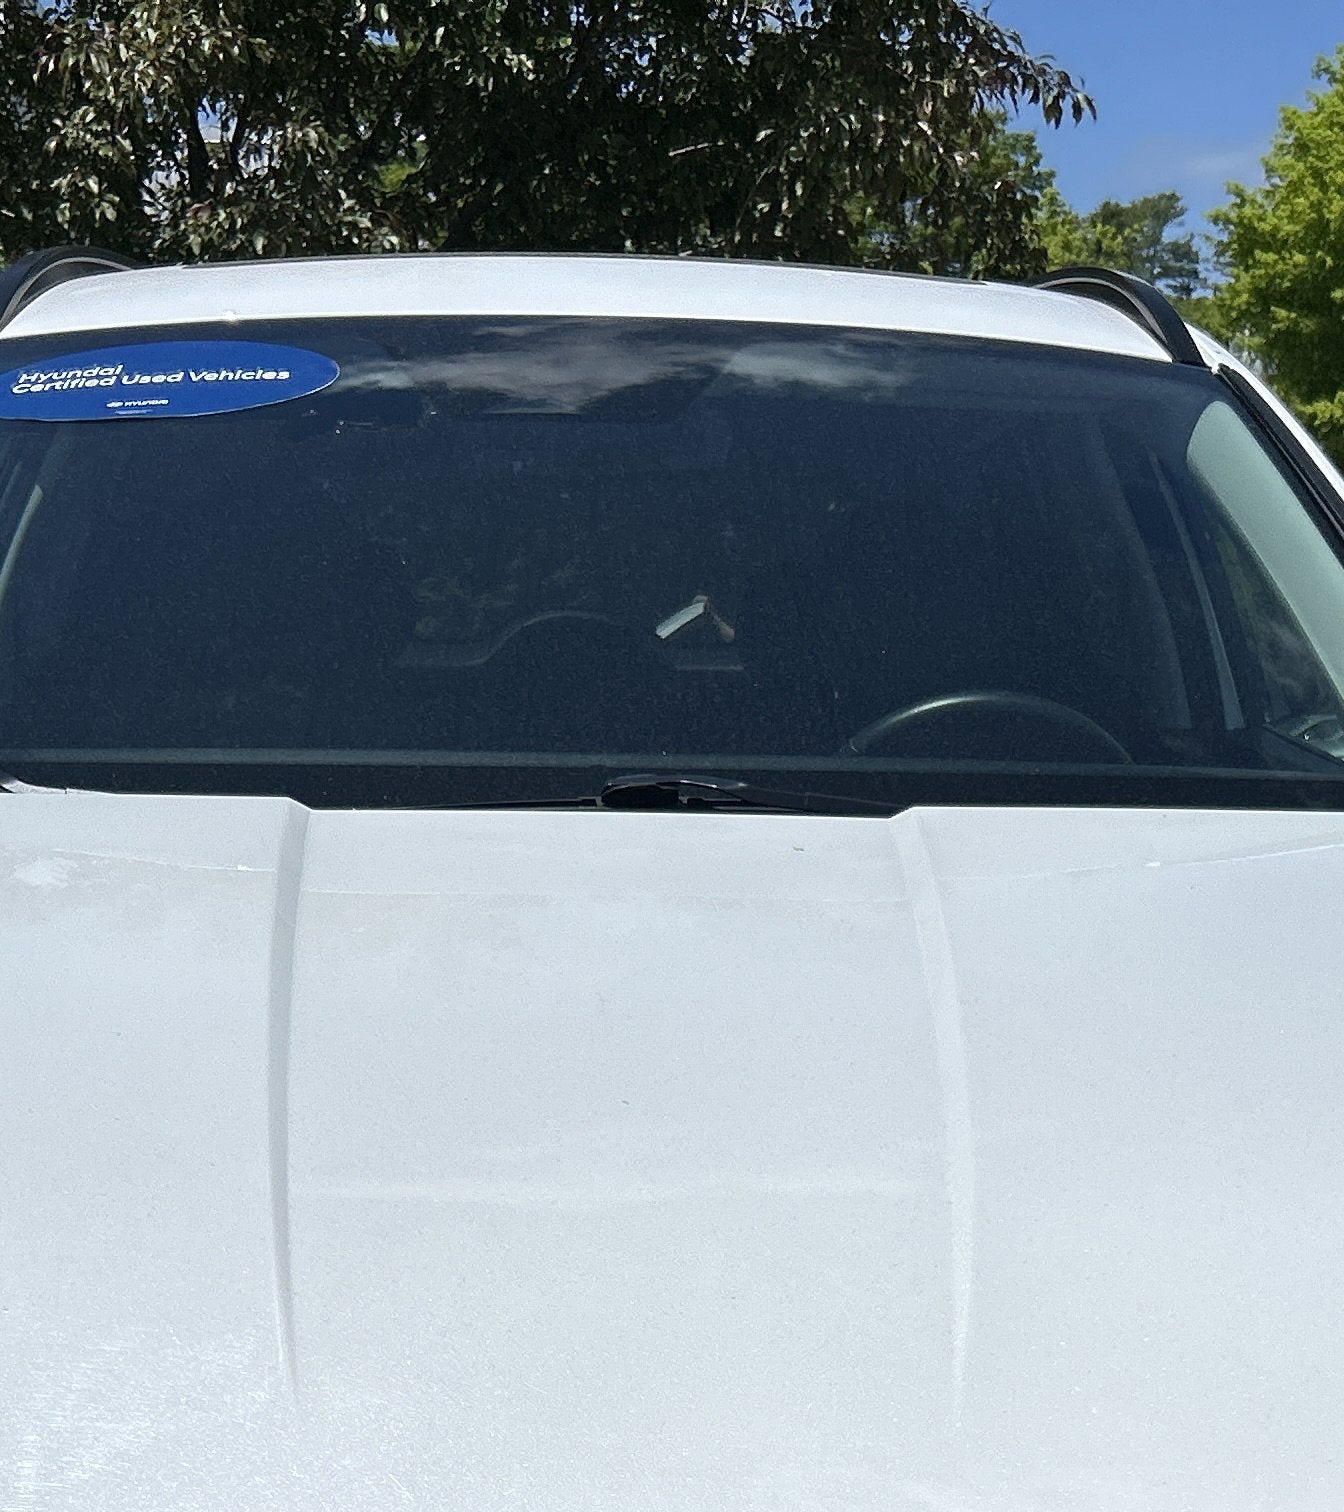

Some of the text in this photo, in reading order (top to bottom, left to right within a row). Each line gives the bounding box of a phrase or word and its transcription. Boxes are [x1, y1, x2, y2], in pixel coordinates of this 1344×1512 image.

[12, 369, 290, 394] Certified Used Vehicles
[18, 364, 123, 384] Hyundai
